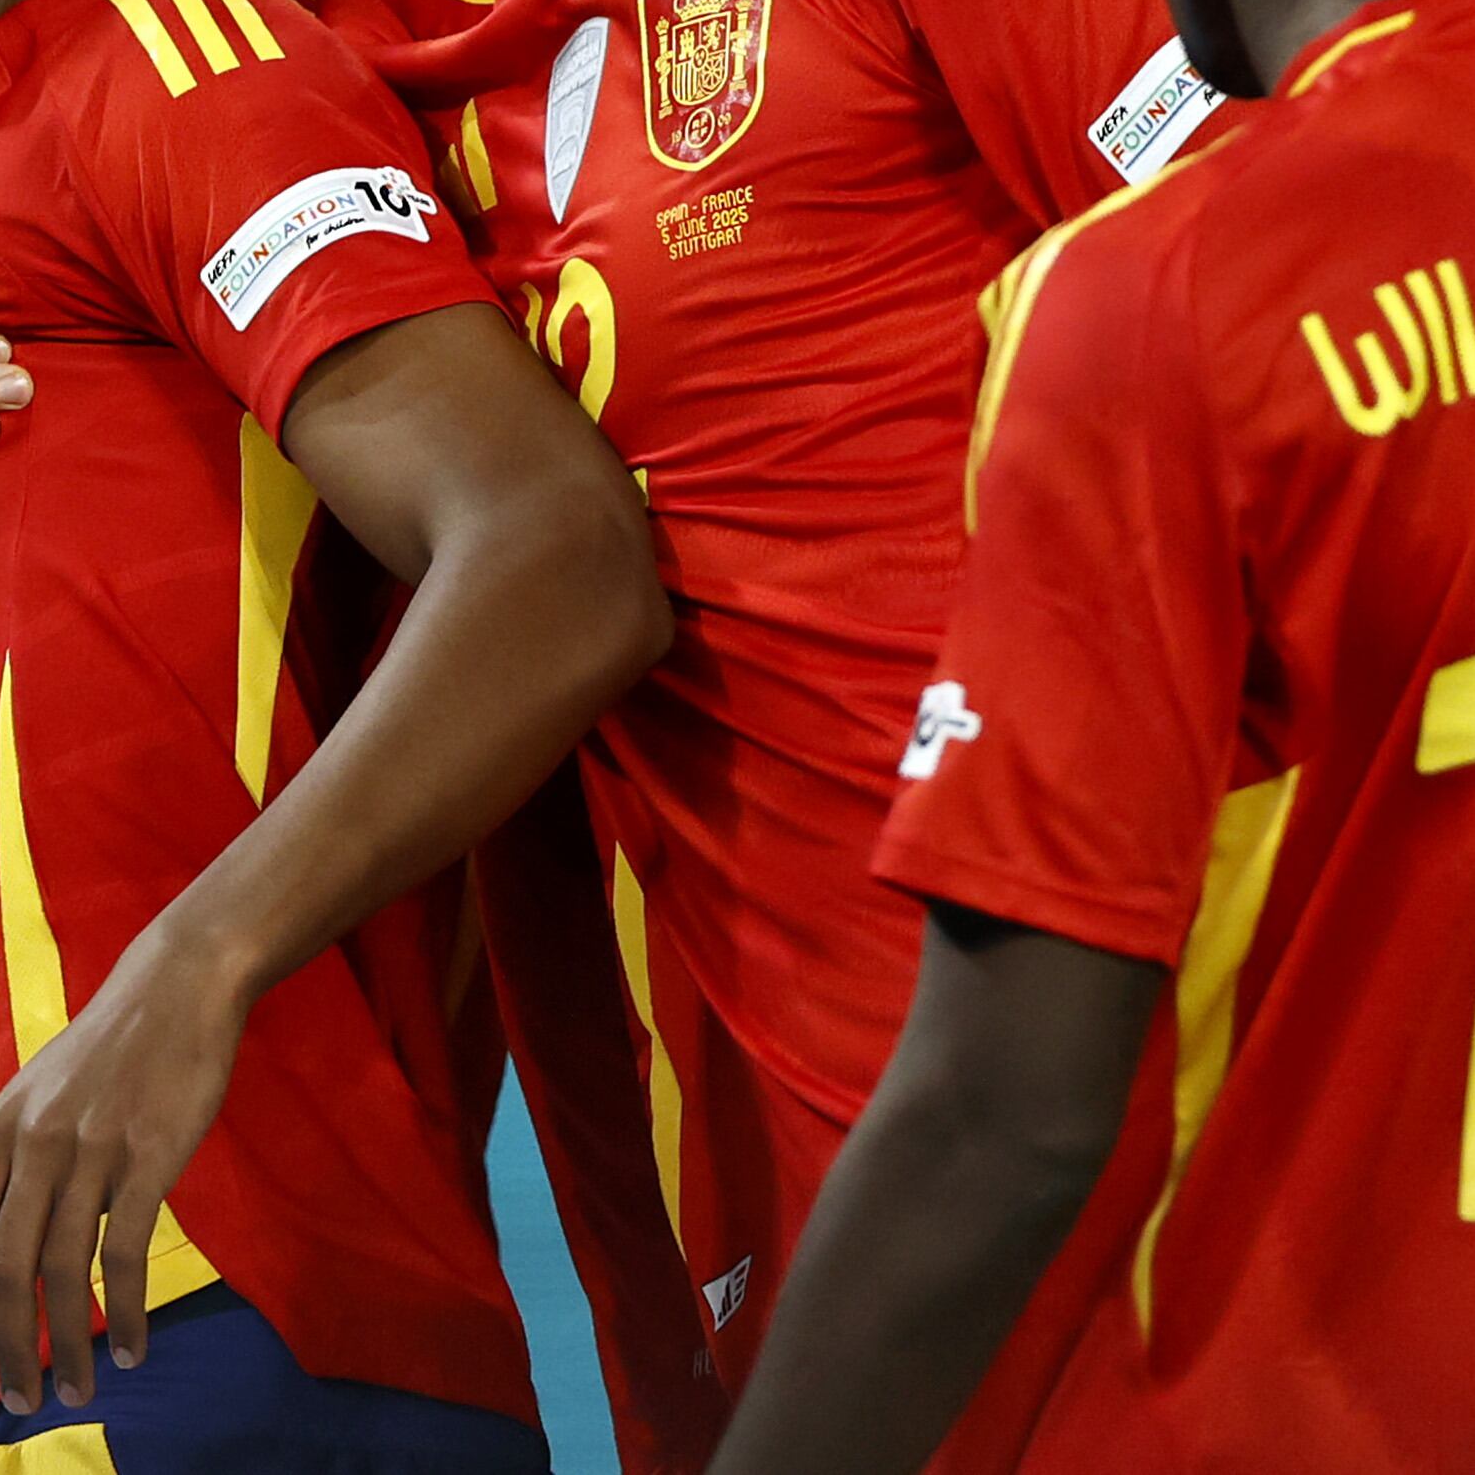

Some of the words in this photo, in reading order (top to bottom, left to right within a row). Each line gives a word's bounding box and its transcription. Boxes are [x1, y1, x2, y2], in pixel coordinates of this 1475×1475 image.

[1096, 105, 1128, 143] UEFA
[353, 180, 412, 218] 10
[655, 202, 690, 229] SPAIN
[701, 185, 755, 215] FRANCE
[305, 232, 320, 250] for
[323, 216, 366, 237] children
[661, 226, 671, 245] 5
[674, 215, 708, 240] JUNE
[711, 205, 750, 230] 2025
[668, 225, 743, 261] STUTTGART
[207, 248, 237, 285] UEFA
[219, 192, 356, 307] FOUNDATION
